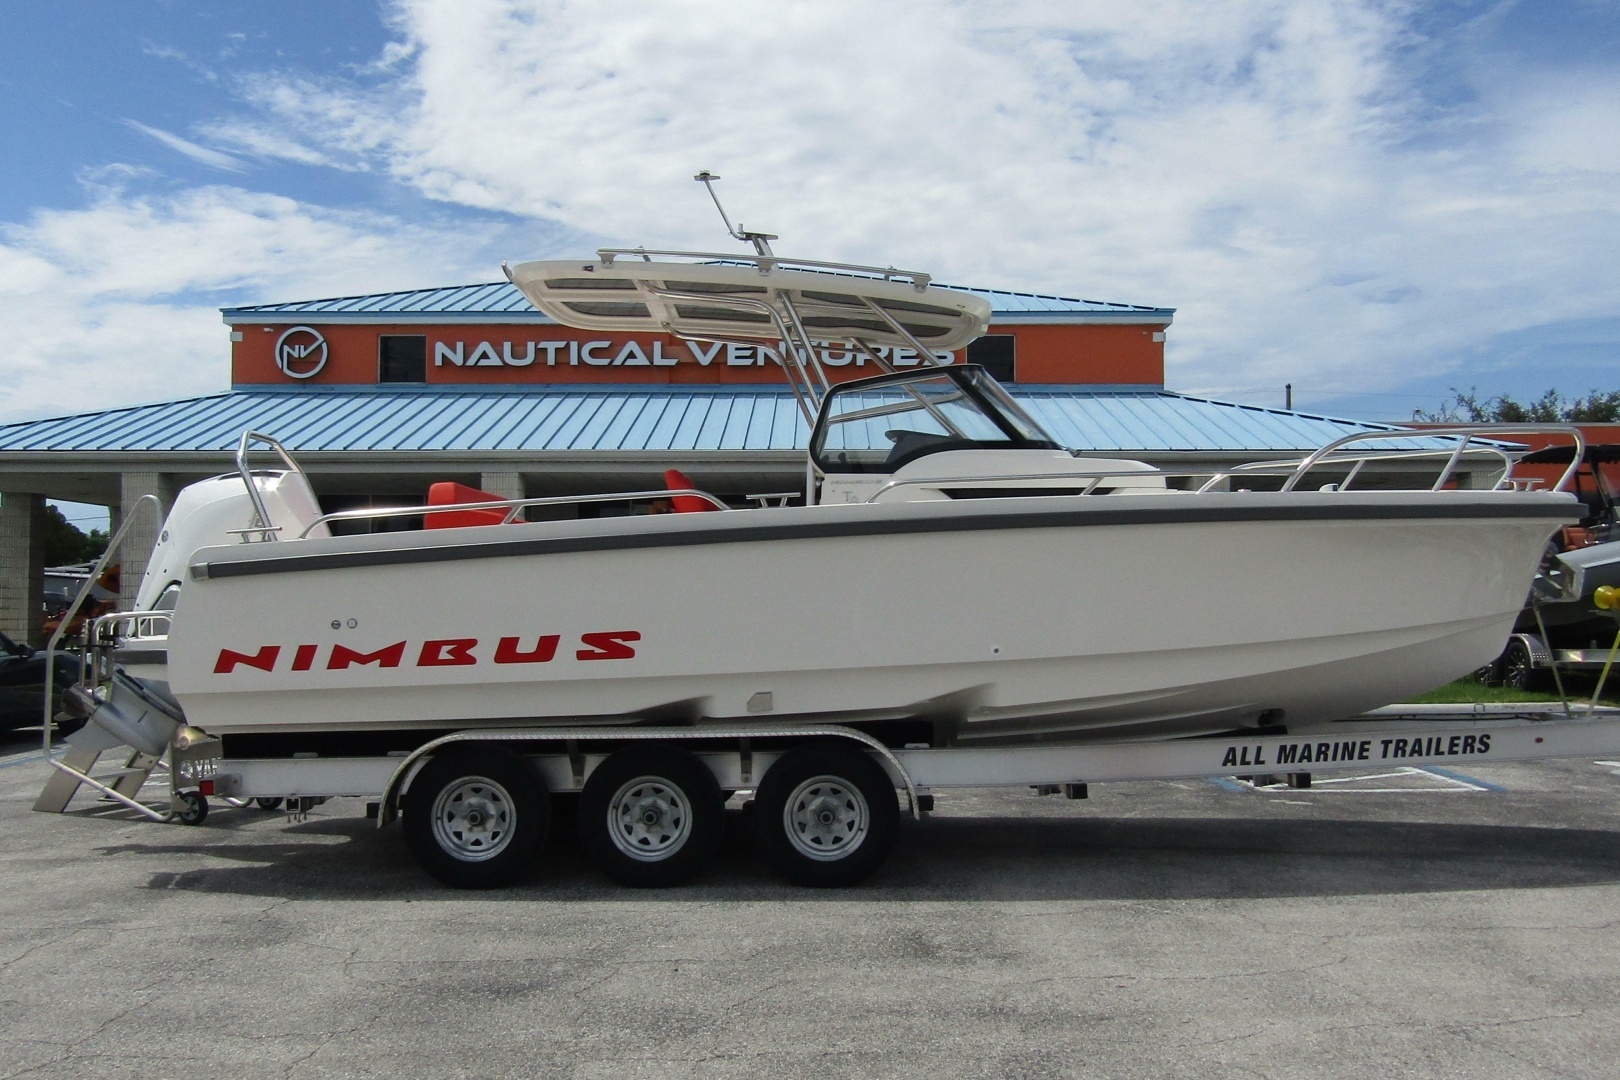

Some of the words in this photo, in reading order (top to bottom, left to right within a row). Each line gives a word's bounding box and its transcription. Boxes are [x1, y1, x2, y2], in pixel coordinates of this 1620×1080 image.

[434, 340, 680, 367] NAUTICAL
[685, 340, 955, 367] VENTURES
[213, 630, 642, 674] NIMBUS
[1221, 745, 1266, 767] ALL
[1276, 740, 1372, 765] MARINE
[1380, 733, 1492, 759] TRAILERS
